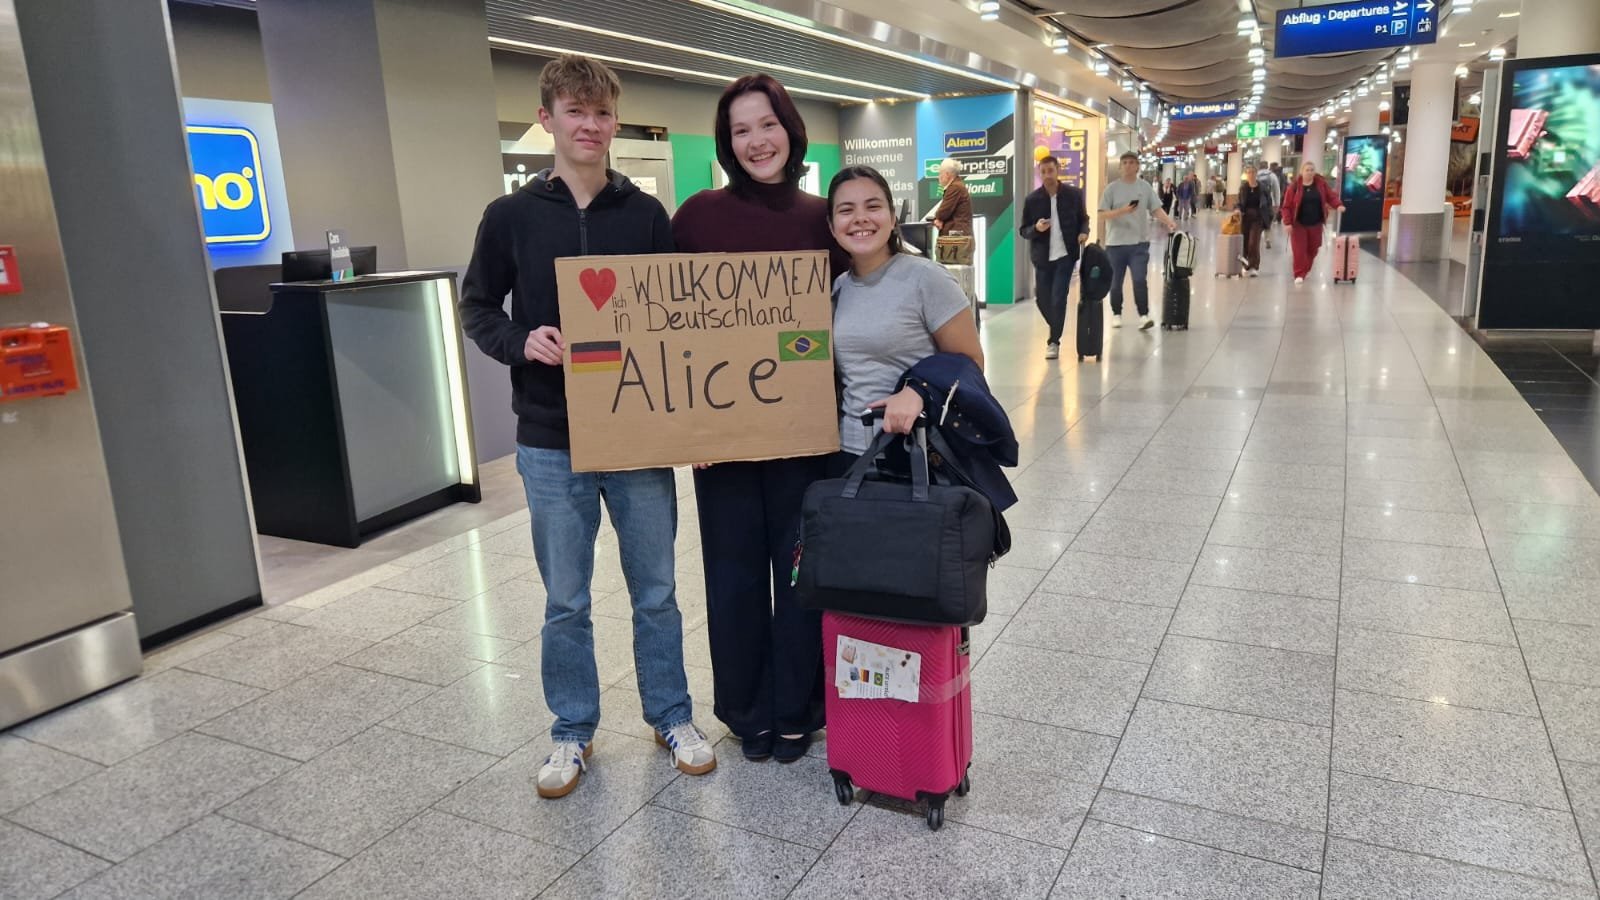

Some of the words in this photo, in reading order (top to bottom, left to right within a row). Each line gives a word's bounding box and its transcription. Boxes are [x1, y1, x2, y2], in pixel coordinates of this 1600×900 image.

[1283, 12, 1320, 25] Abflug
[1328, 5, 1390, 21] Departures
[1375, 25, 1387, 33] P1
[844, 137, 913, 151] Willkommen
[947, 137, 985, 148] Alamo
[845, 153, 904, 165] Bienvenue
[930, 158, 1005, 173] erprise
[611, 295, 627, 309] lich
[614, 310, 631, 334] in
[611, 341, 783, 414] Alice
